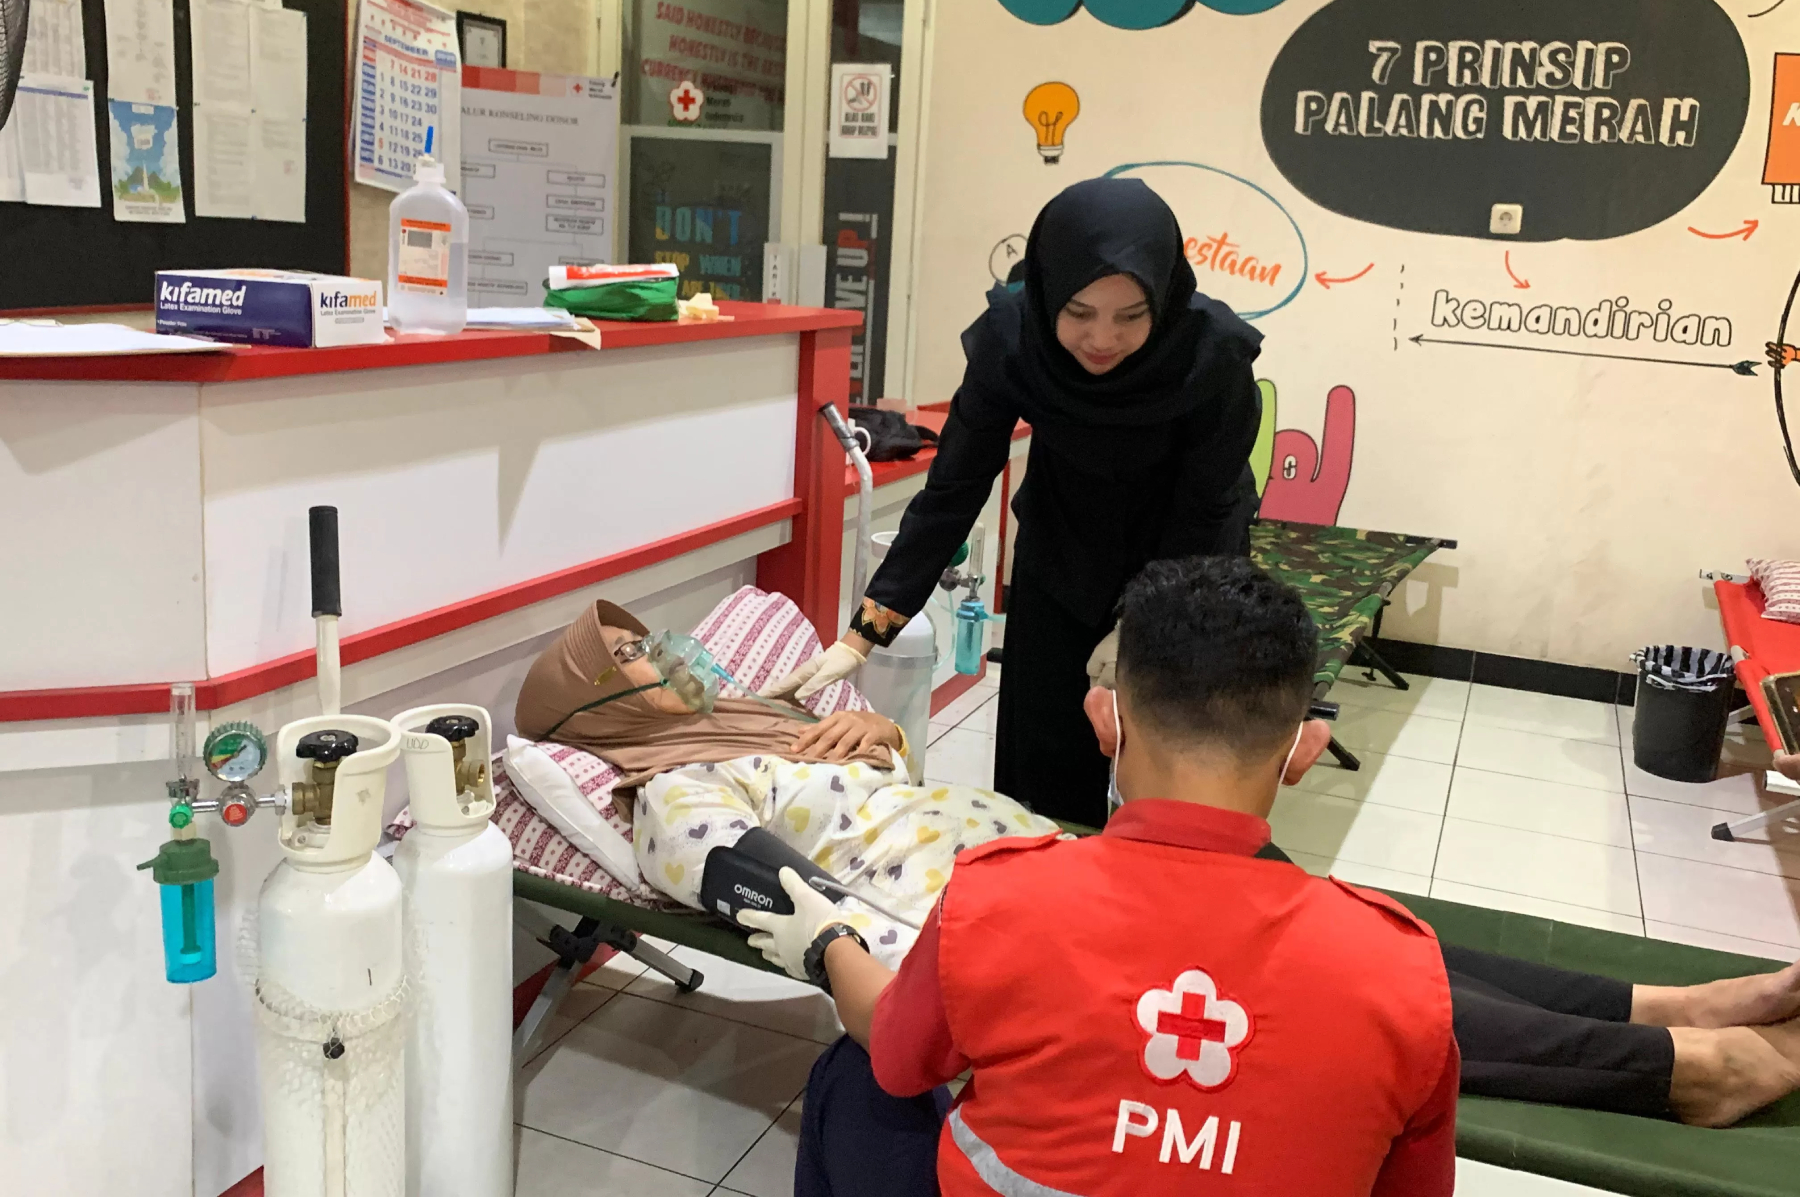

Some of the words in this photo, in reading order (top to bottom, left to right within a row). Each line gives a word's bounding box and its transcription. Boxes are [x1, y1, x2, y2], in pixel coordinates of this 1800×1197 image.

[399, 63, 408, 76] 14
[411, 67, 421, 79] 21
[424, 71, 437, 83] 28
[1368, 40, 1401, 85] 7
[1412, 40, 1631, 91] PRINSIP
[410, 83, 422, 95] 22
[411, 100, 422, 112] 23
[424, 102, 437, 115] 30
[400, 112, 409, 124] 17
[412, 116, 423, 127] 24
[1294, 90, 1488, 140] PALANG
[1502, 95, 1700, 147] MERAH
[389, 125, 398, 136] 11
[388, 141, 399, 153] 12
[388, 157, 399, 170] 13
[655, 205, 742, 246] DON'T
[1006, 243, 1018, 259] A
[160, 302, 178, 311] Latex
[180, 303, 221, 314] Examination
[222, 306, 243, 316] Glove
[1431, 288, 1733, 348] kemandirian
[734, 883, 773, 909] OMRON
[1111, 1098, 1241, 1174] PMI
